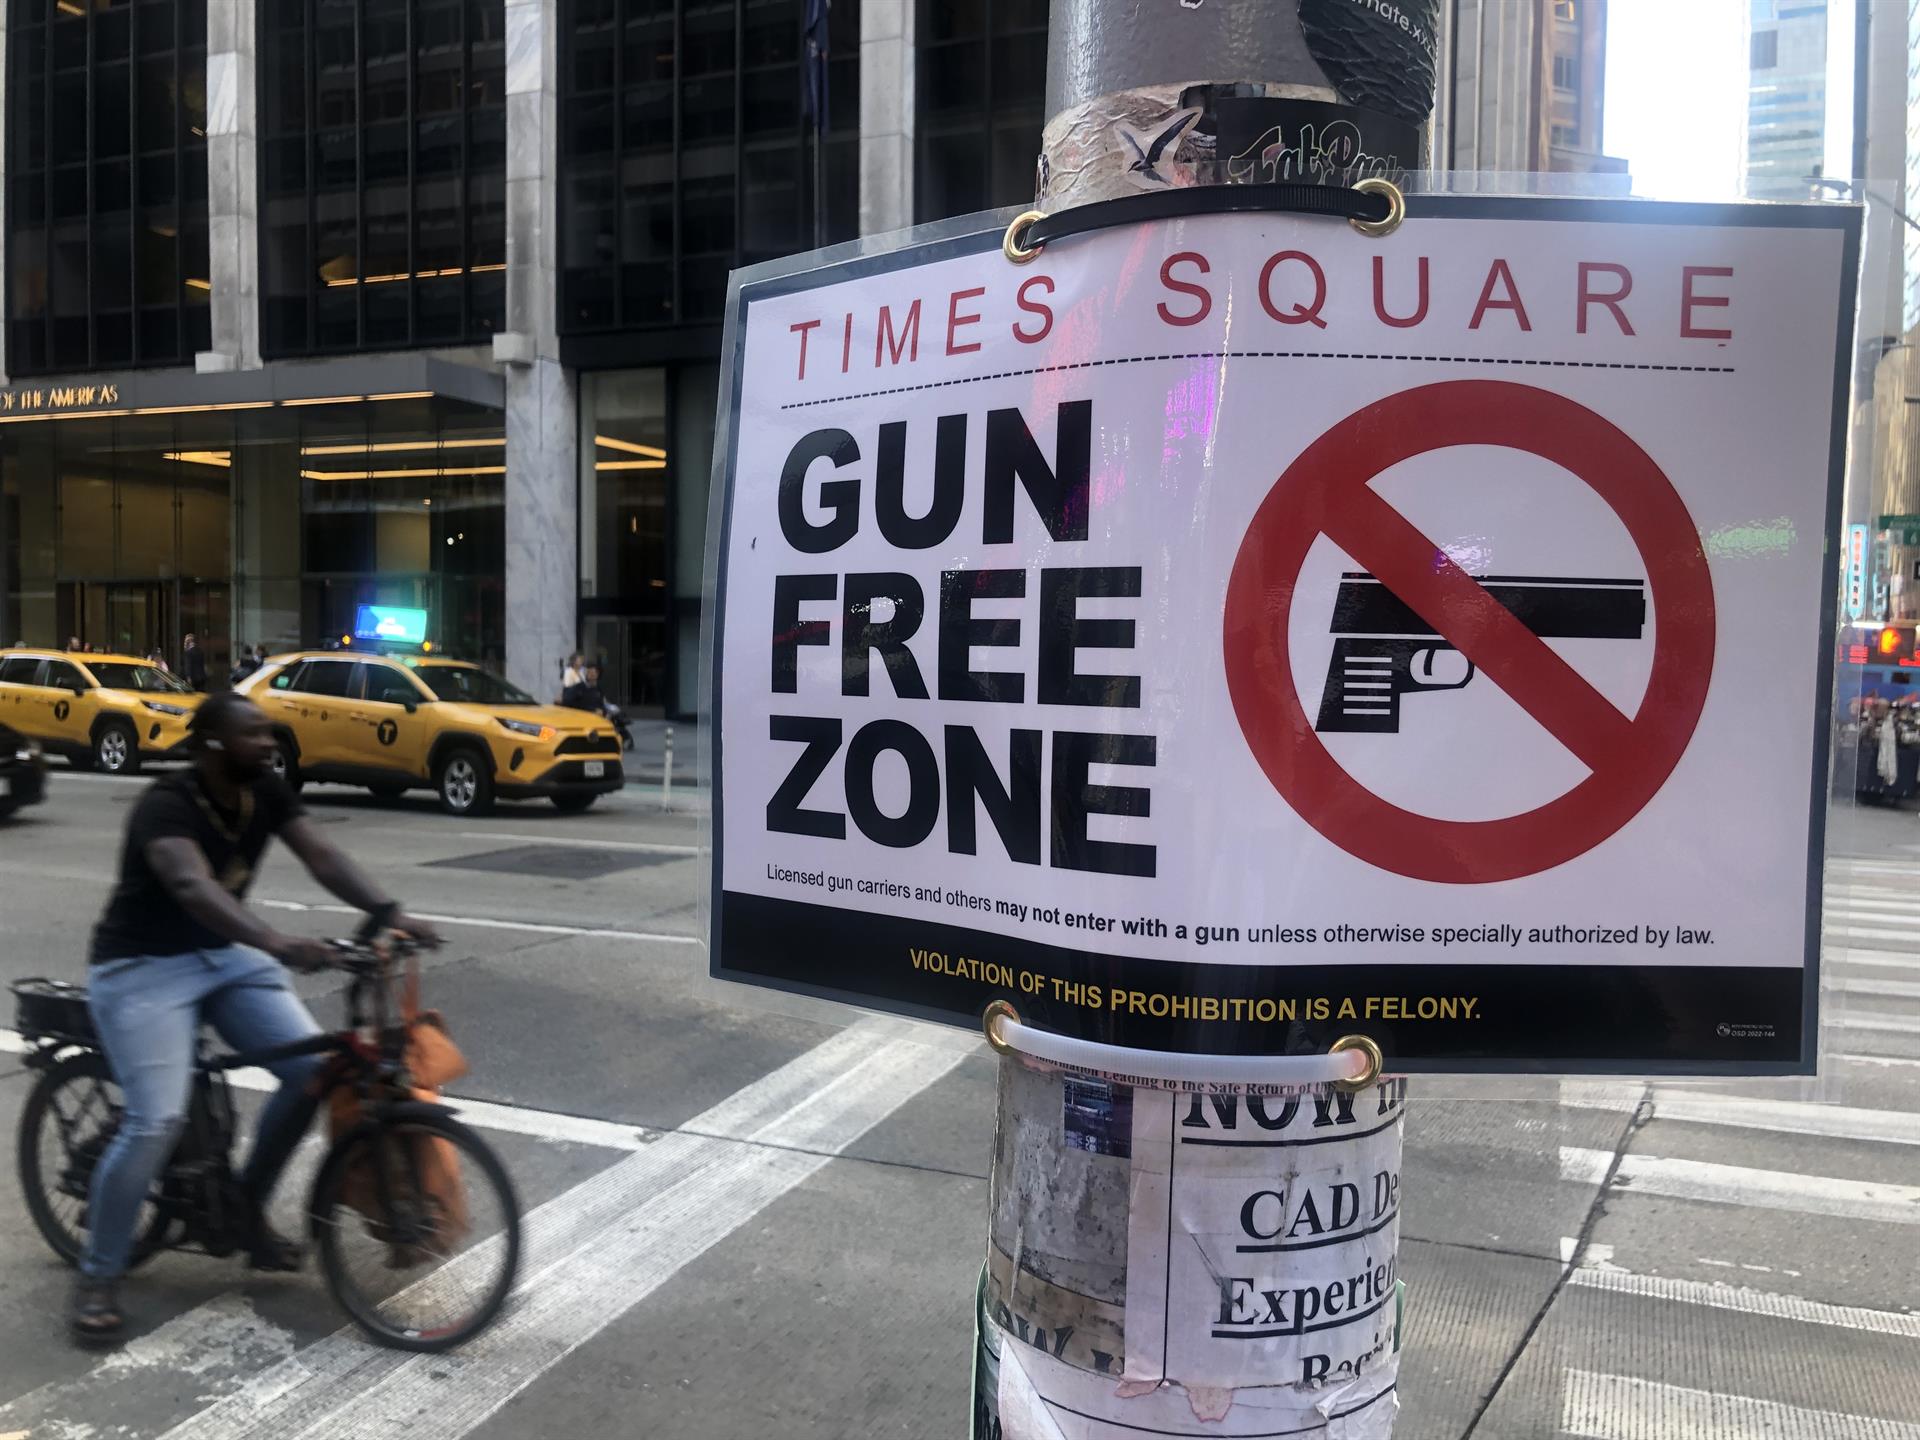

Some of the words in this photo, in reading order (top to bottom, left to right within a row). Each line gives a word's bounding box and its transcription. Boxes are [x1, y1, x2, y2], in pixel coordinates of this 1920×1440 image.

[790, 275, 1055, 381] TIMES
[1156, 250, 1734, 340] SQUARE
[777, 399, 1093, 554] GUN
[771, 566, 1142, 709] FREE
[766, 714, 1157, 878] ZONE
[767, 863, 824, 887] Licensed
[828, 873, 853, 892] gun
[857, 878, 911, 899] carriers
[915, 886, 942, 904] and
[946, 892, 992, 912] others
[996, 899, 1028, 923] may
[1033, 908, 1060, 925] not
[1064, 913, 1116, 933] enter
[1121, 917, 1168, 938] with
[1175, 923, 1188, 939] a
[1195, 926, 1240, 945] gun
[1248, 924, 1317, 943] unless
[1323, 924, 1425, 943] otherwise
[1431, 923, 1522, 947] specially
[1528, 924, 1639, 945] authorized
[1645, 925, 1669, 948] by
[1676, 926, 1715, 945] law.
[909, 948, 1014, 989] VIOLATION
[1020, 970, 1046, 995] OF
[1051, 977, 1102, 1009] THIS
[1111, 988, 1296, 1022] PROHIBITION
[1306, 997, 1330, 1020] IS
[1337, 998, 1357, 1019] A
[1365, 997, 1481, 1020] FELONY.
[1163, 1078, 1177, 1090] to
[1182, 1080, 1205, 1092] the
[1246, 1082, 1295, 1096] Return
[1240, 1182, 1360, 1240] CAD
